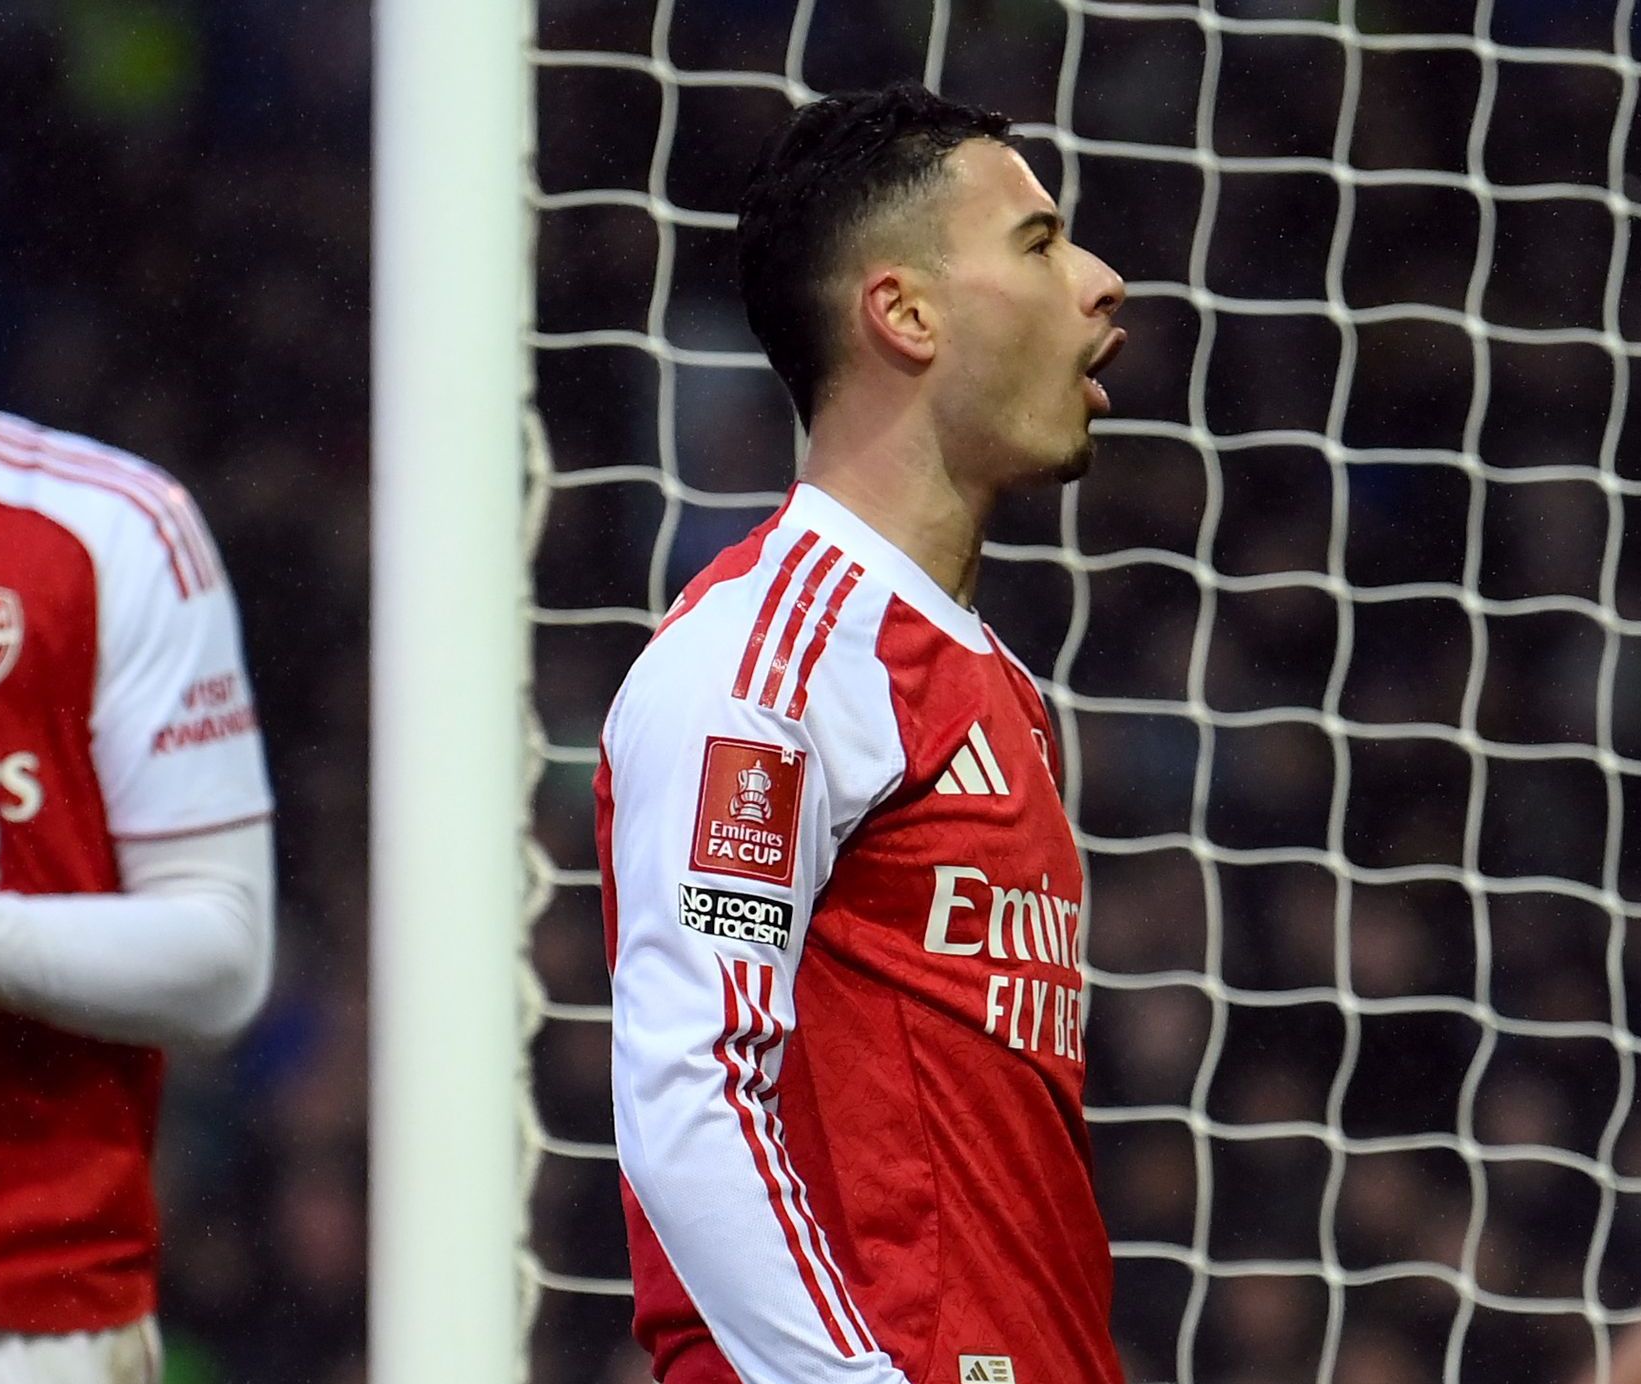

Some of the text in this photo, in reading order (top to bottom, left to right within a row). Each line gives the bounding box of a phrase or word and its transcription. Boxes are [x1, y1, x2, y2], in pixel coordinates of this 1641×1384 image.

[707, 838, 782, 866] FA CUP
[710, 820, 784, 848] Emirates
[680, 885, 784, 926] No room
[680, 904, 789, 949] for racism
[984, 974, 1049, 1052] FLY
